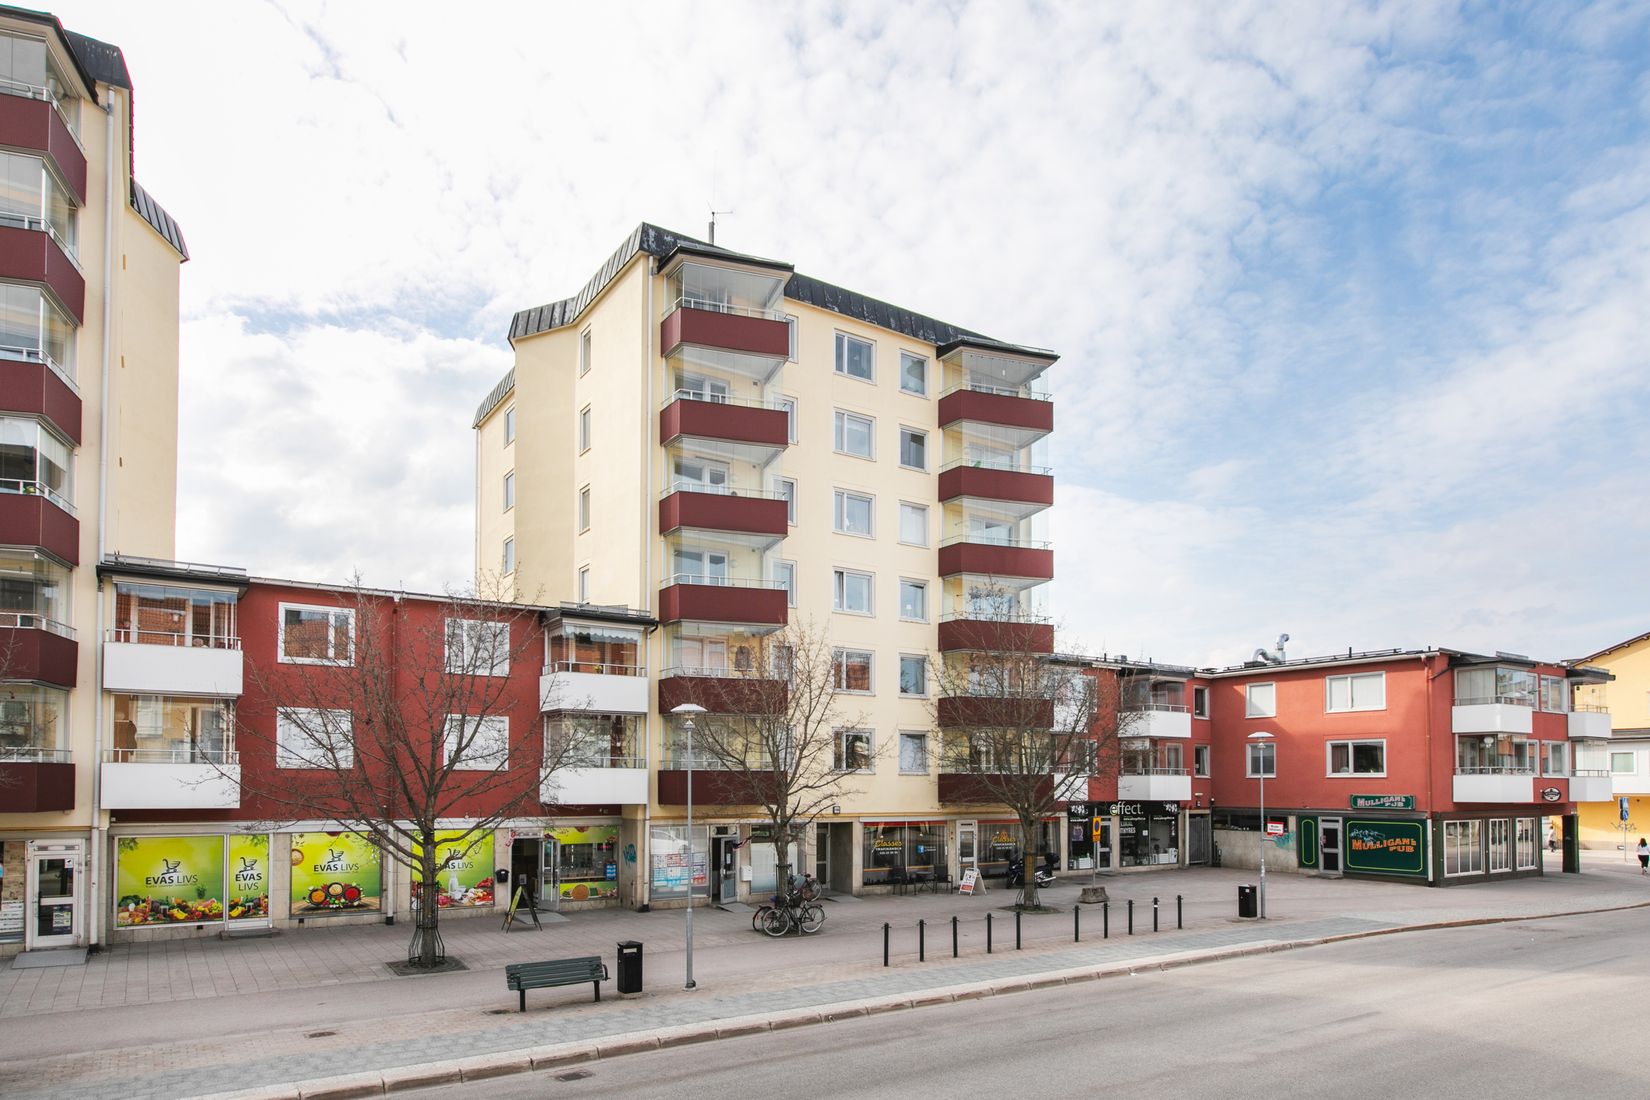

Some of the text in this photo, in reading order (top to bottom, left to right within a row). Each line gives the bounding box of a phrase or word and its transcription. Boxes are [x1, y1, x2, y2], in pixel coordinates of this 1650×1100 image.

[313, 863, 359, 872] EVAS LIVS
[458, 861, 474, 869] LIVS
[145, 874, 199, 885] EVAS LIVS
[235, 872, 262, 882] EVAS
[238, 882, 259, 891] LIVS
